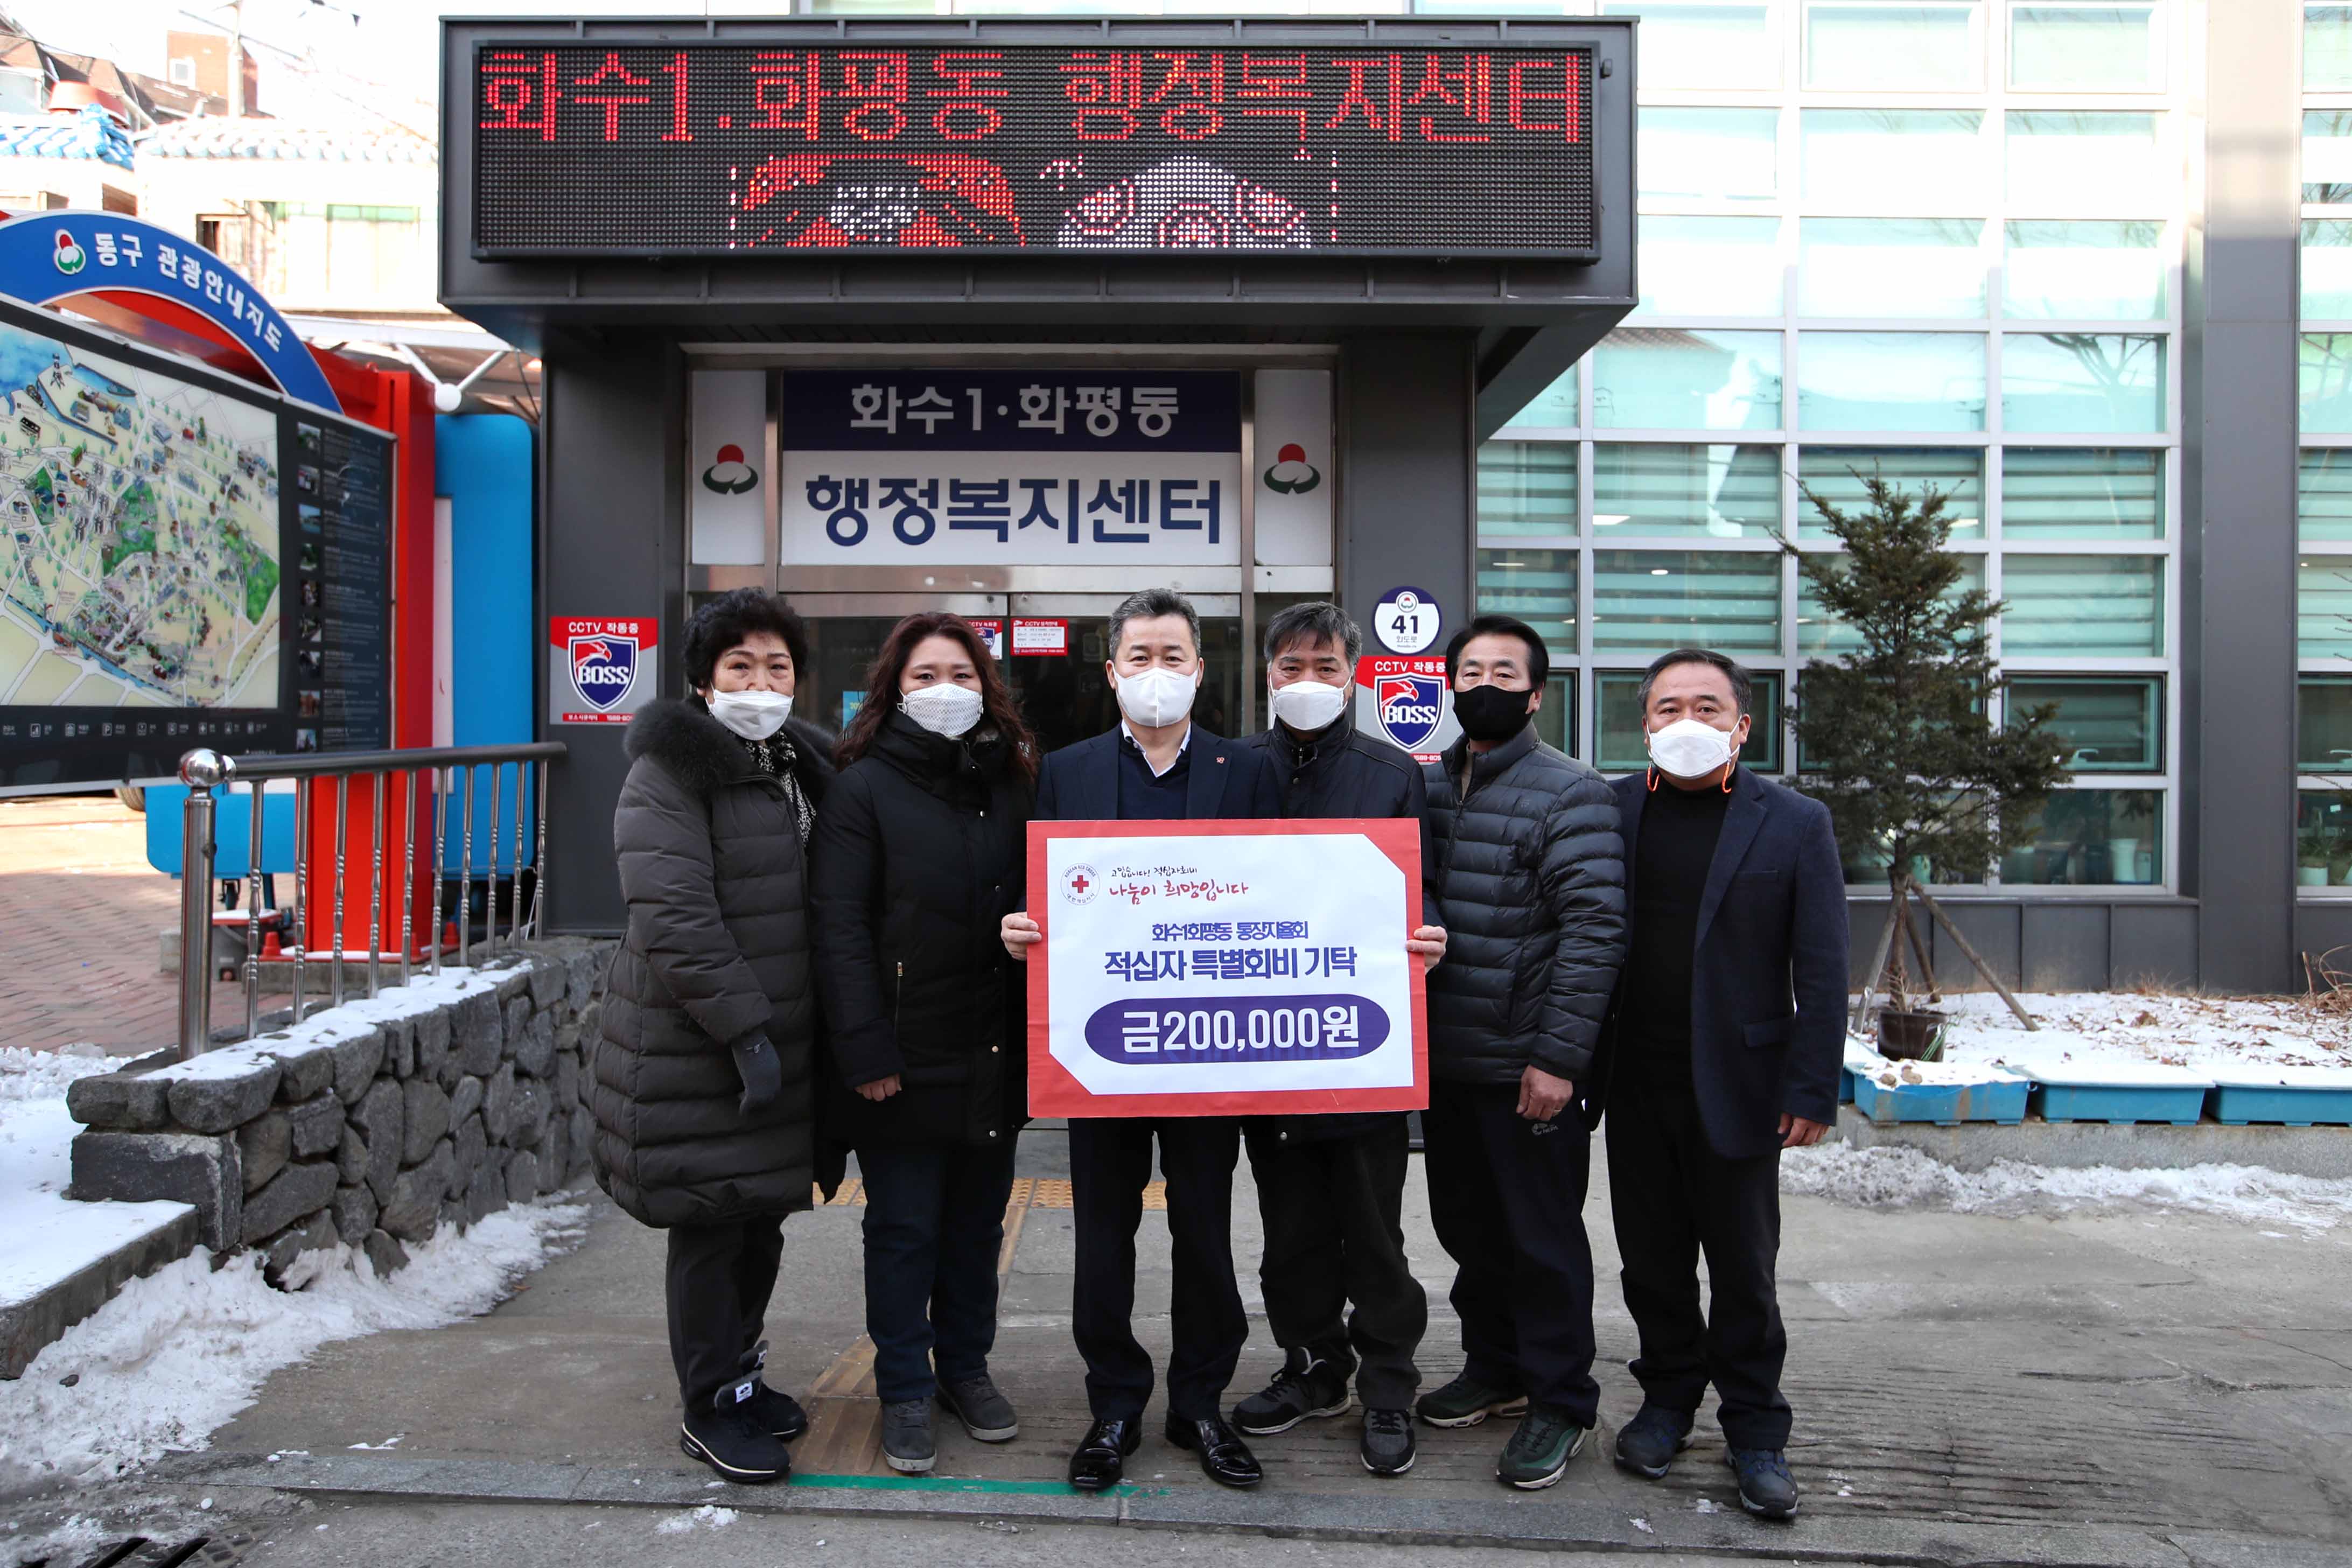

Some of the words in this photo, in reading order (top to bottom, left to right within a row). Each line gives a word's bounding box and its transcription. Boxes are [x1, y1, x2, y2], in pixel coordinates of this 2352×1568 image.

[1059, 52, 1579, 142] 행정복지센터
[95, 233, 144, 268] 동구
[158, 243, 282, 353] 관광안내지도
[805, 474, 1220, 546] 행정복지센터
[569, 622, 601, 633] CCTV
[1391, 615, 1418, 634] 41
[578, 666, 629, 684] BOSS
[1375, 661, 1409, 672] CCTV
[1414, 661, 1445, 673] 작동중
[1384, 705, 1437, 724] BOSS
[1154, 865, 1198, 877] 적십자회비
[1110, 882, 1157, 905] 나눔이
[1164, 878, 1249, 901] 희망입니다
[1236, 920, 1309, 941] 통장자율회
[1104, 950, 1187, 982] 적십자
[1191, 948, 1298, 980] 특별회비
[1304, 946, 1358, 978] 기탁
[1122, 1005, 1360, 1054] 금200,000원
